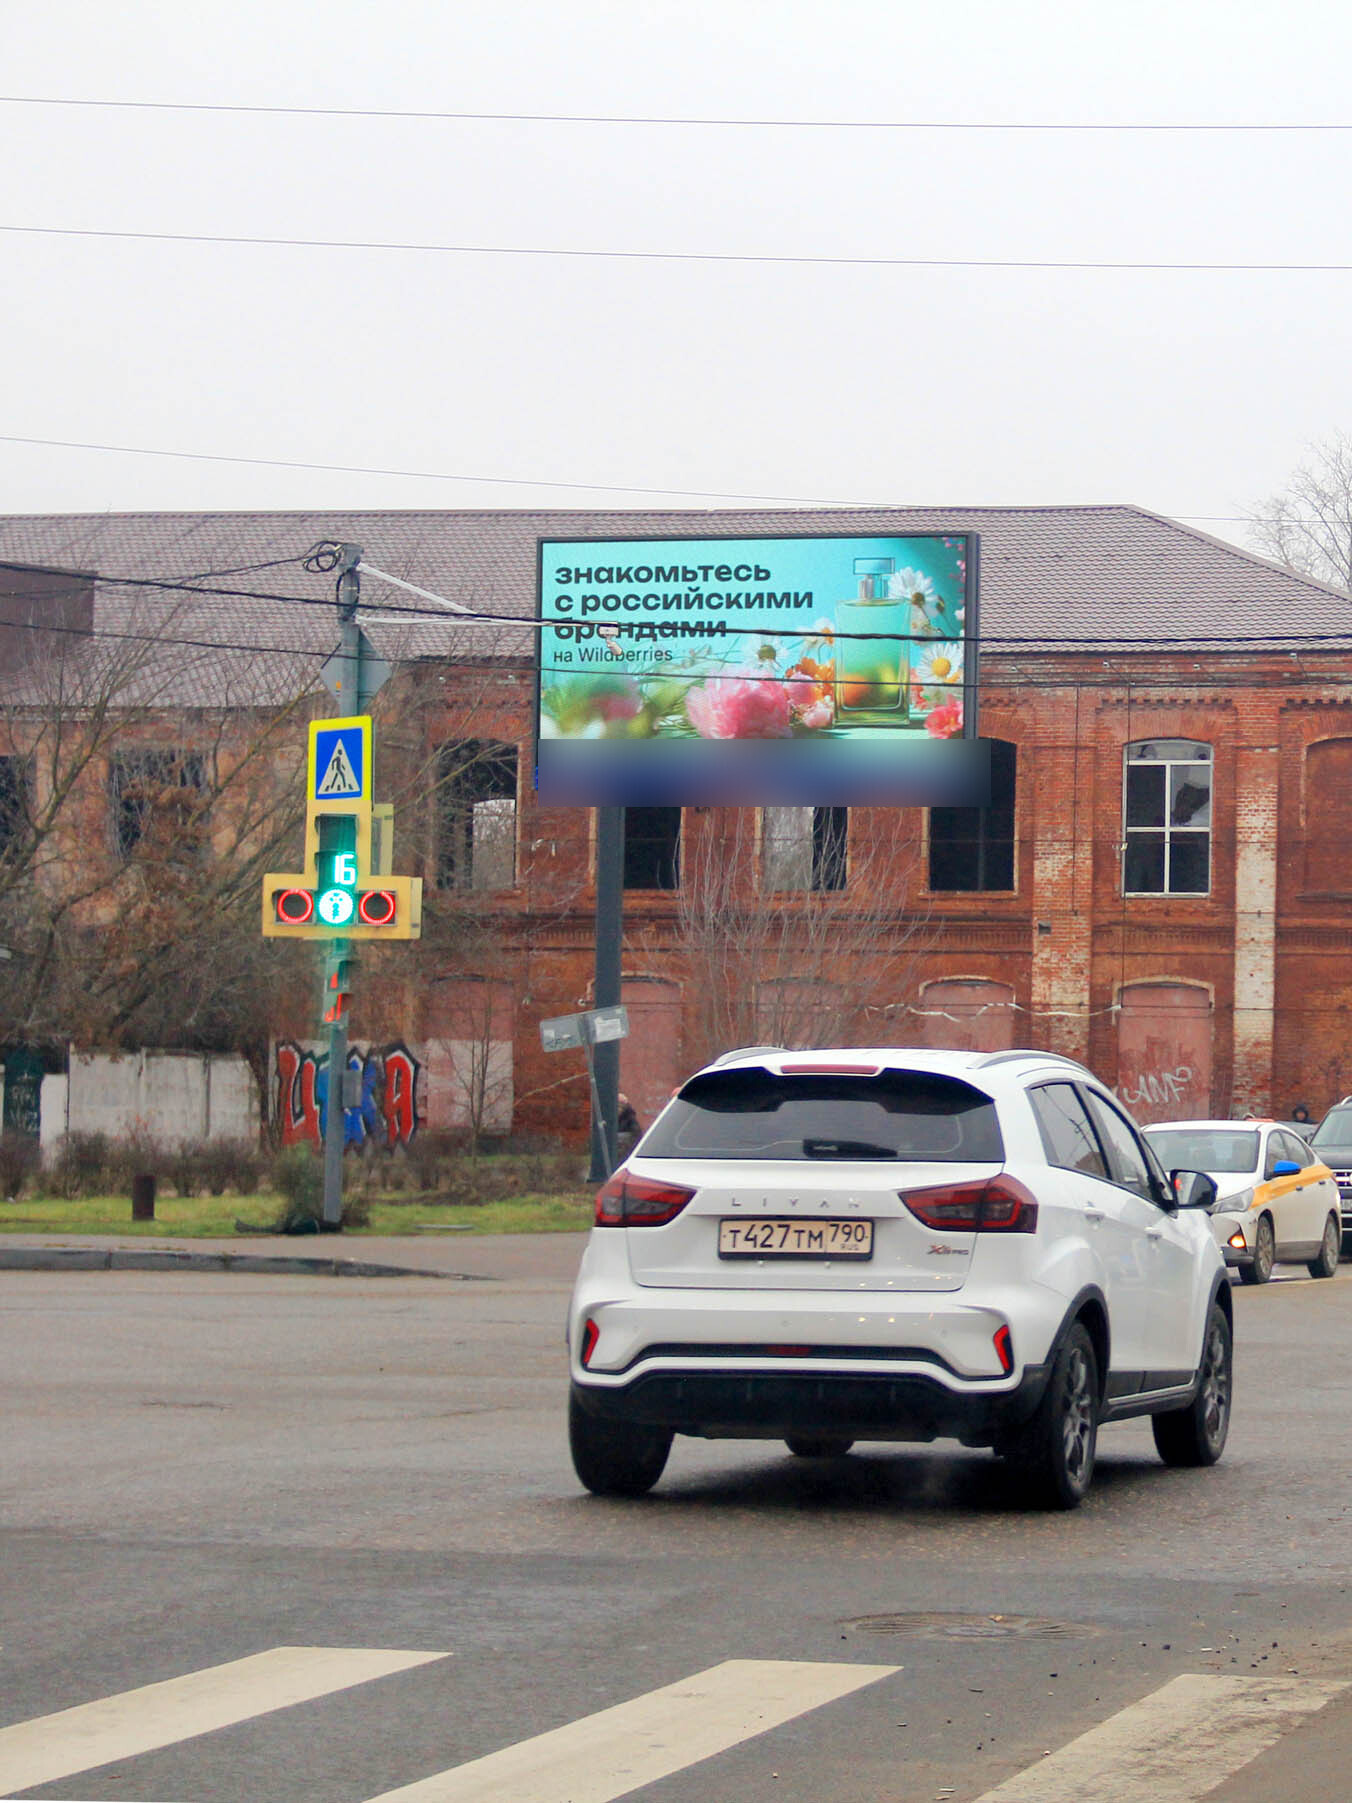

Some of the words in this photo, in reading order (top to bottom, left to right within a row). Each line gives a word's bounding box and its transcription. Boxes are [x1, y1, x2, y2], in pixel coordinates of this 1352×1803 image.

[555, 564, 771, 585] знакомьтесь
[554, 594, 574, 612] с
[581, 586, 813, 616] российскими
[553, 650, 573, 663] на
[334, 853, 356, 885] 16
[728, 1223, 824, 1249] Т427ТМ
[829, 1223, 866, 1243] 790
